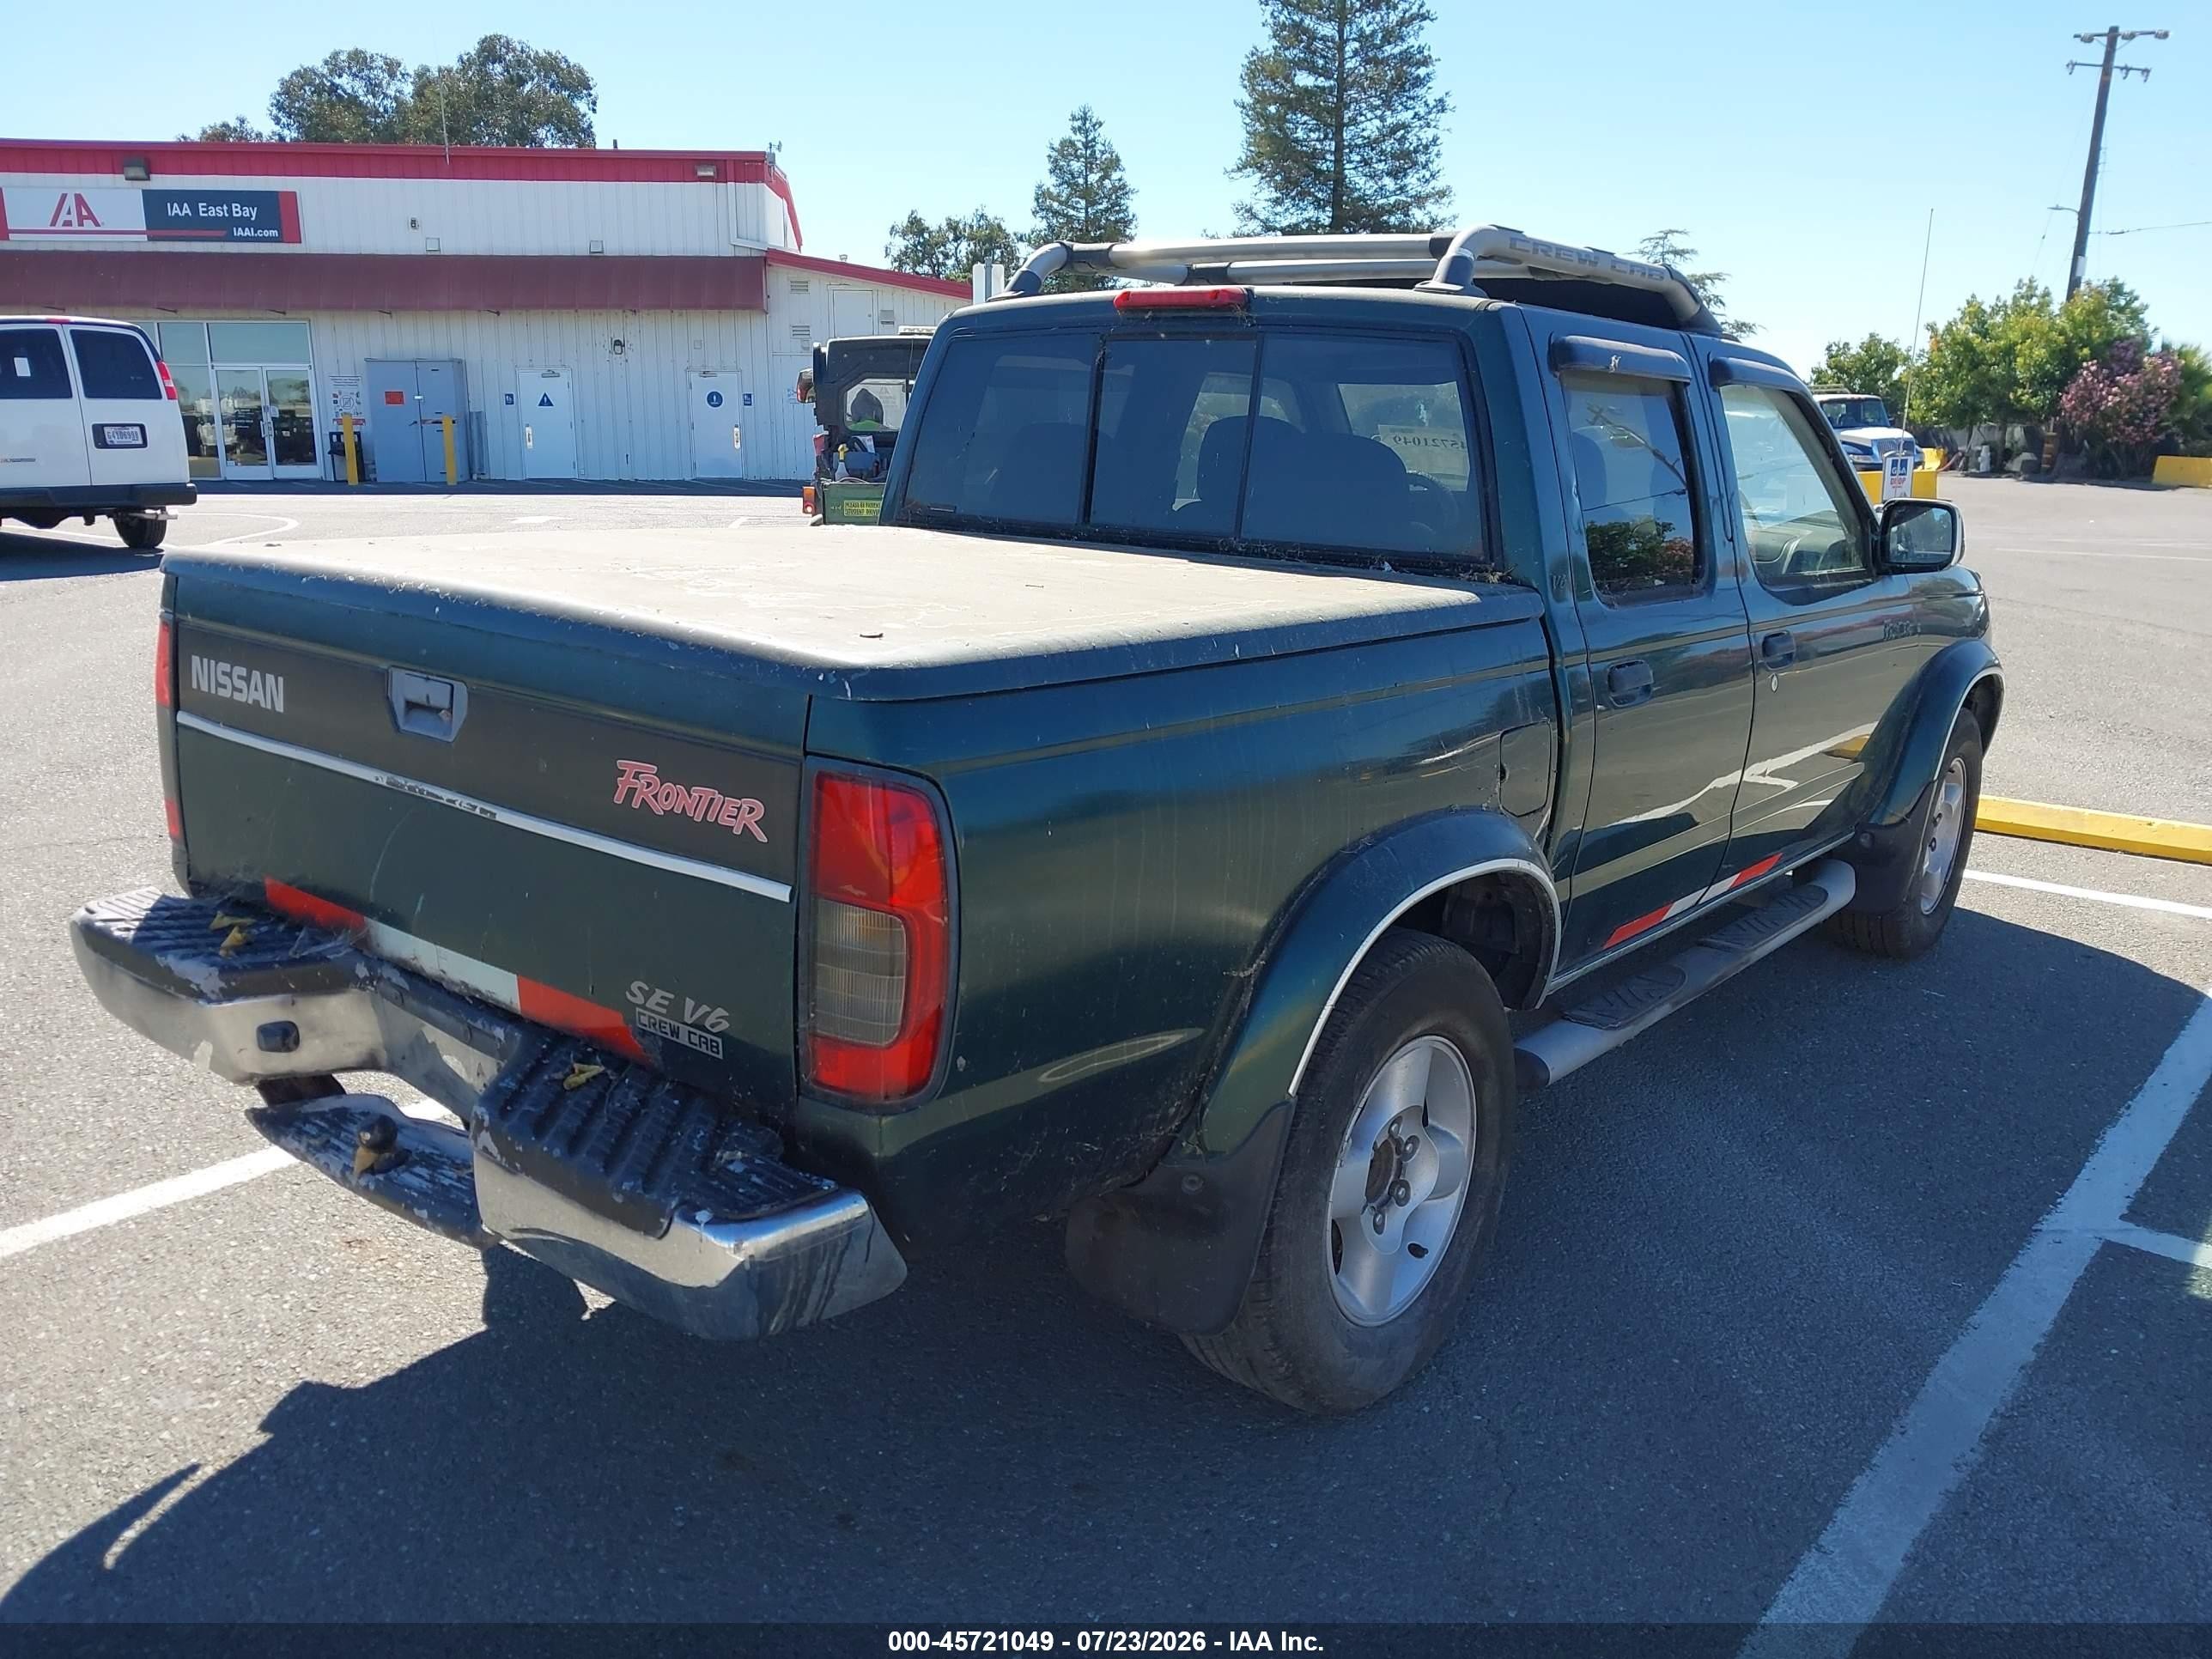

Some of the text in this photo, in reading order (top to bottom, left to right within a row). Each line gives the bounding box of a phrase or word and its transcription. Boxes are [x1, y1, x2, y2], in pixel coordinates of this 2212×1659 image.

[167, 202, 258, 221] IAA East Bay
[233, 227, 279, 238] IAAI.com
[1509, 236, 1600, 268] CREW
[191, 654, 284, 713] NISSAN
[613, 760, 769, 843] FRONTIER
[625, 981, 730, 1033] SE V6
[638, 1011, 721, 1056] CREW CAB
